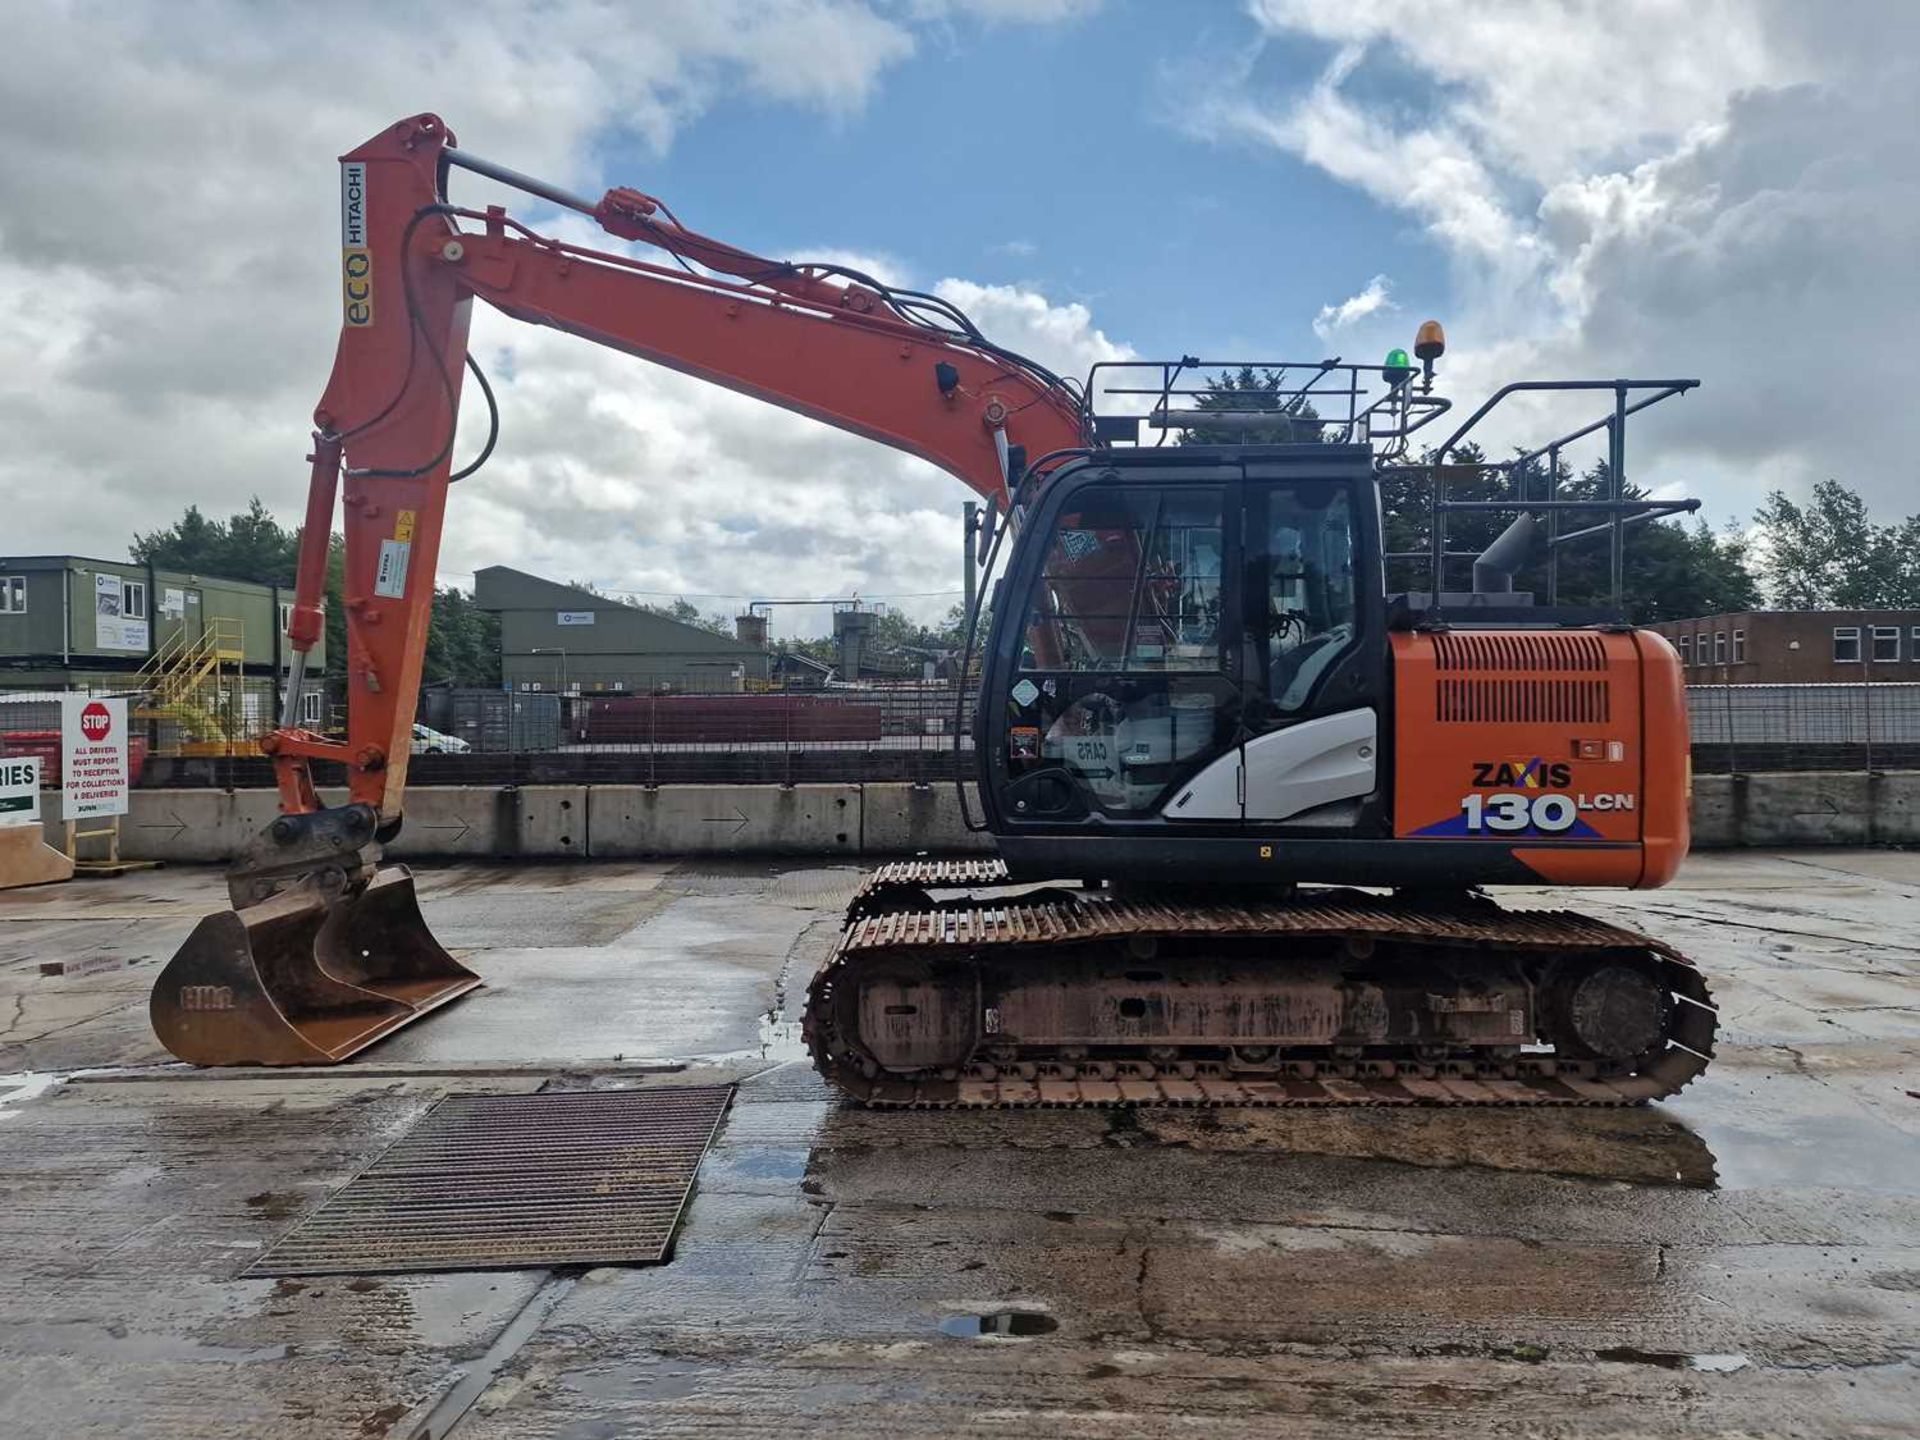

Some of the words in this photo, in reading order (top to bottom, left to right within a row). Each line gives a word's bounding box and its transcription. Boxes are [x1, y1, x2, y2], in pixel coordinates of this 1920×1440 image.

[349, 168, 361, 244] HITACHI
[347, 254, 369, 324] eco
[83, 715, 109, 729] STOP
[75, 747, 87, 755] ALL
[90, 746, 117, 754] DRIVERS
[73, 758, 91, 766] MUST
[93, 757, 119, 765] REPORT
[0, 764, 34, 786] IES
[84, 768, 120, 777] RECEPTION
[1472, 757, 1571, 788] ZAXIS
[66, 781, 80, 789] FOR
[82, 779, 125, 788] COLLECTIONS
[81, 790, 118, 800] DELIVERIES
[1461, 793, 1577, 831] 130
[1578, 794, 1634, 810] LCN
